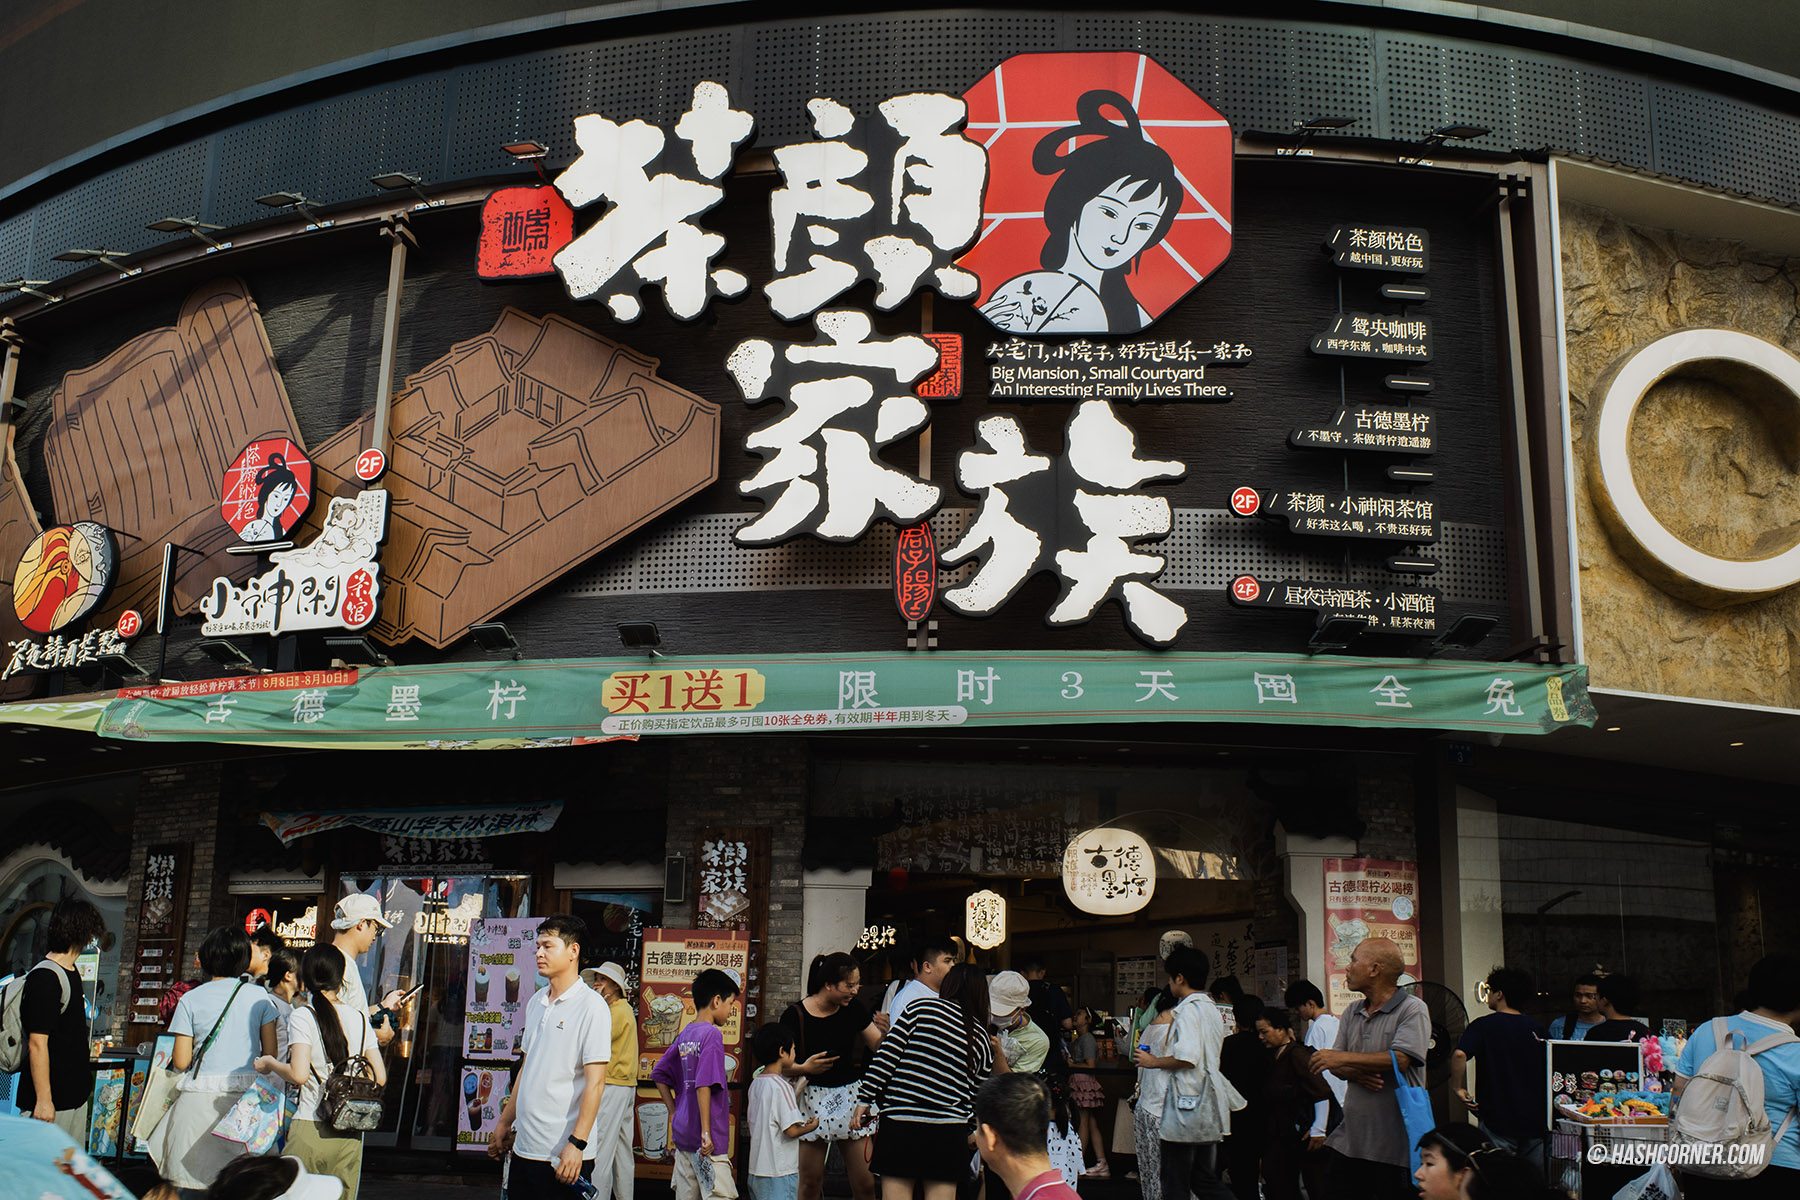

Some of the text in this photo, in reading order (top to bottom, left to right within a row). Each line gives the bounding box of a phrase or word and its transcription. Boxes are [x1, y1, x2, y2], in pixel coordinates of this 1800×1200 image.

[1349, 228, 1423, 252] 茶颜悦色
[1349, 251, 1423, 269] 越中国，更好玩
[1352, 316, 1427, 341] 鸳央咖啡
[1327, 338, 1427, 356] 西学东渐，咖啡中式
[992, 367, 1014, 382] Big
[1090, 366, 1128, 380] Small
[1131, 366, 1204, 382] Courtyard
[992, 383, 1013, 396] An
[1016, 383, 1093, 396] Interesting
[1096, 383, 1142, 399] Family
[1146, 383, 1182, 396] Lives
[1354, 410, 1429, 433] 古德墨柠
[359, 457, 380, 473] 2F
[1235, 494, 1256, 509] 2F
[1237, 583, 1256, 595] 2F
[120, 617, 136, 631] 2F
[609, 669, 752, 714] 买1送1
[1328, 880, 1414, 896] 古德墨柠必喝榜
[646, 950, 744, 968] 古德墨柠必喝榜
